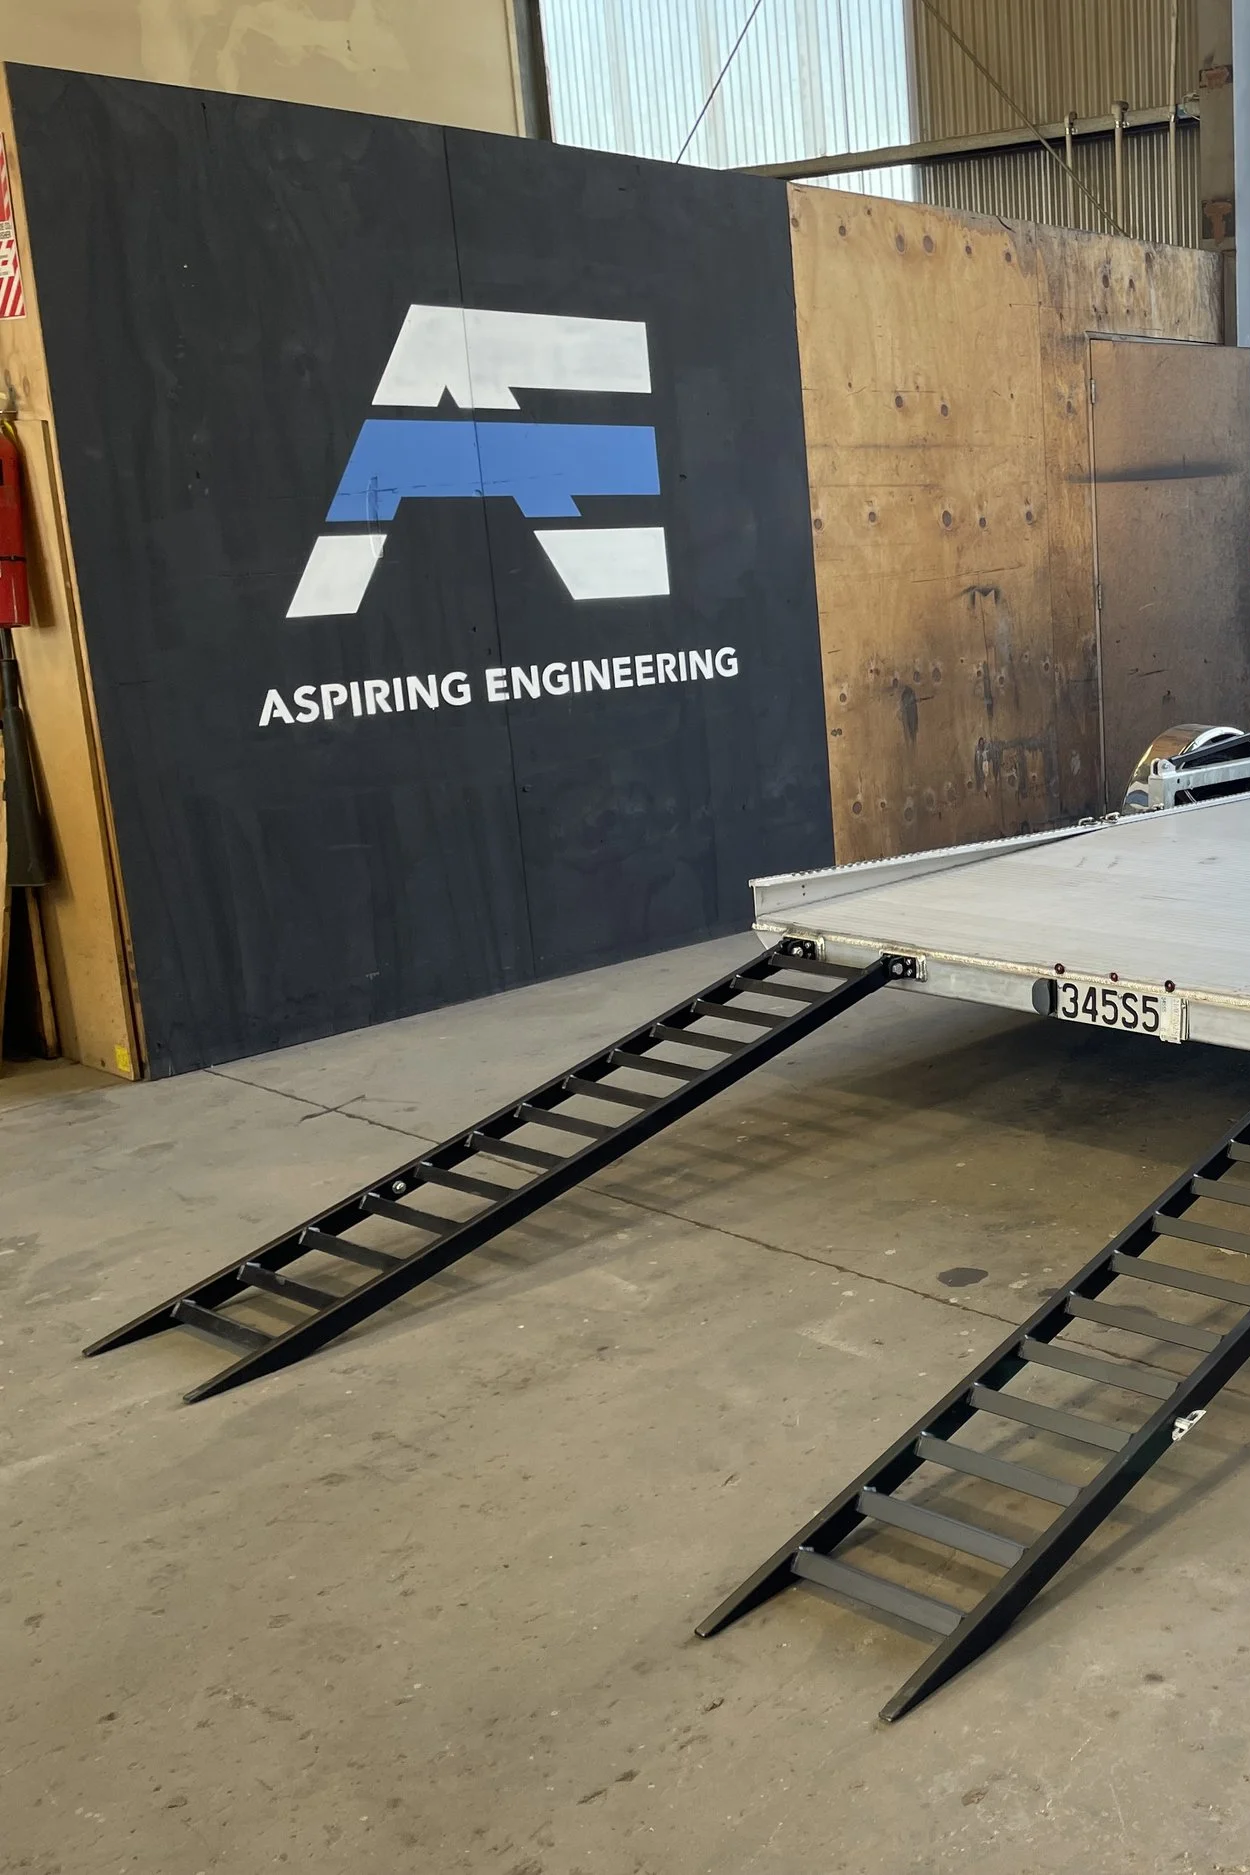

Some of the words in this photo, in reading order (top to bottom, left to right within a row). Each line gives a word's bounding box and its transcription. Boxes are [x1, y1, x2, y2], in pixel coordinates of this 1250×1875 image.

[258, 671, 472, 727] ASPIRING
[485, 646, 739, 703] ENGINEERING
[1061, 982, 1160, 1033] 345S5
